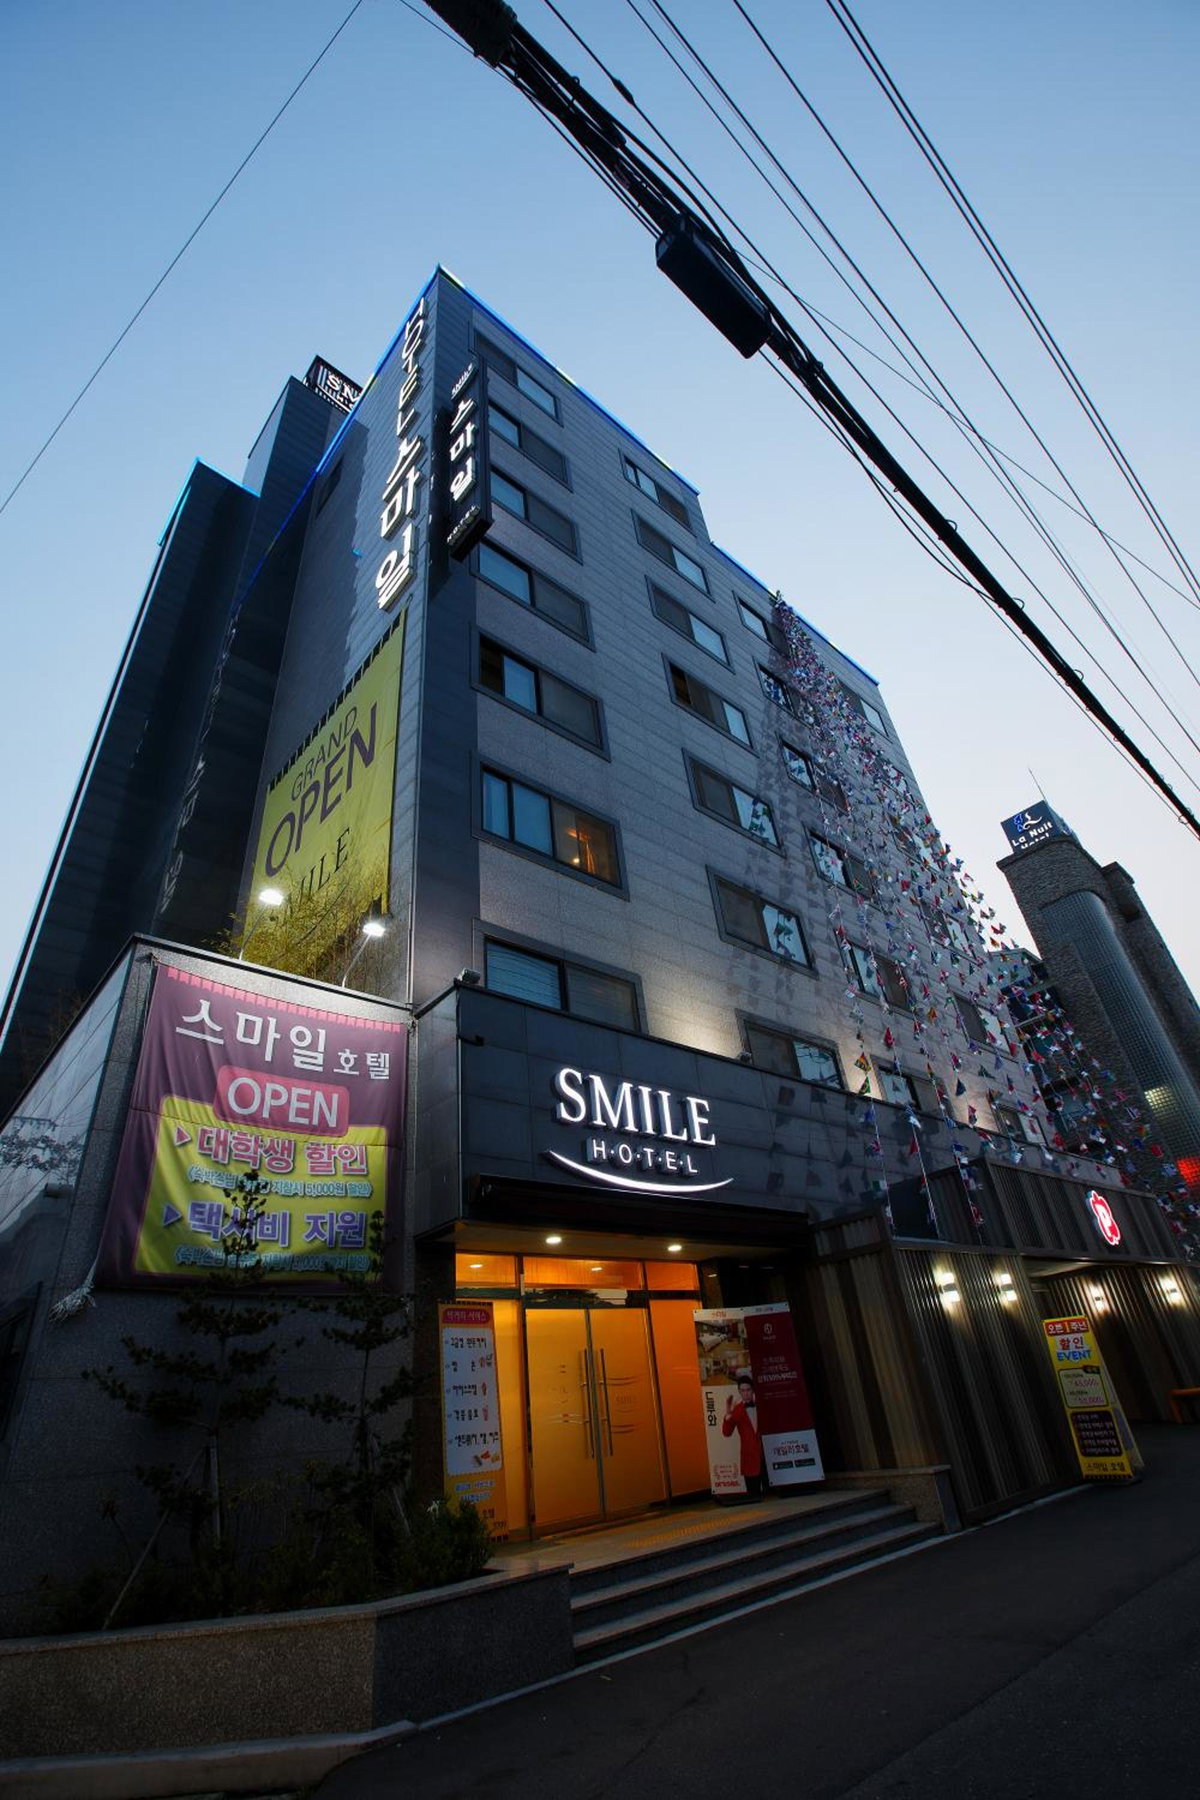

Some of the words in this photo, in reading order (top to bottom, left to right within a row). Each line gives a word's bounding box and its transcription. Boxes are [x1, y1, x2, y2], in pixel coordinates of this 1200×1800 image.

[450, 399, 477, 501] 스마일
[375, 434, 423, 610] 스마일
[290, 705, 358, 802] GRAND
[265, 701, 378, 877] OPEN
[1011, 835, 1027, 848] La
[175, 999, 327, 1072] 스마일
[333, 1049, 391, 1081] 호텔
[227, 1076, 340, 1128] OPEN
[555, 1067, 717, 1146] SMILE
[197, 1125, 296, 1173] 대학생
[305, 1142, 370, 1176] 할인
[302, 1208, 367, 1249] 지원
[1056, 1349, 1091, 1363] EVENT
[1059, 1336, 1085, 1350] 할인
